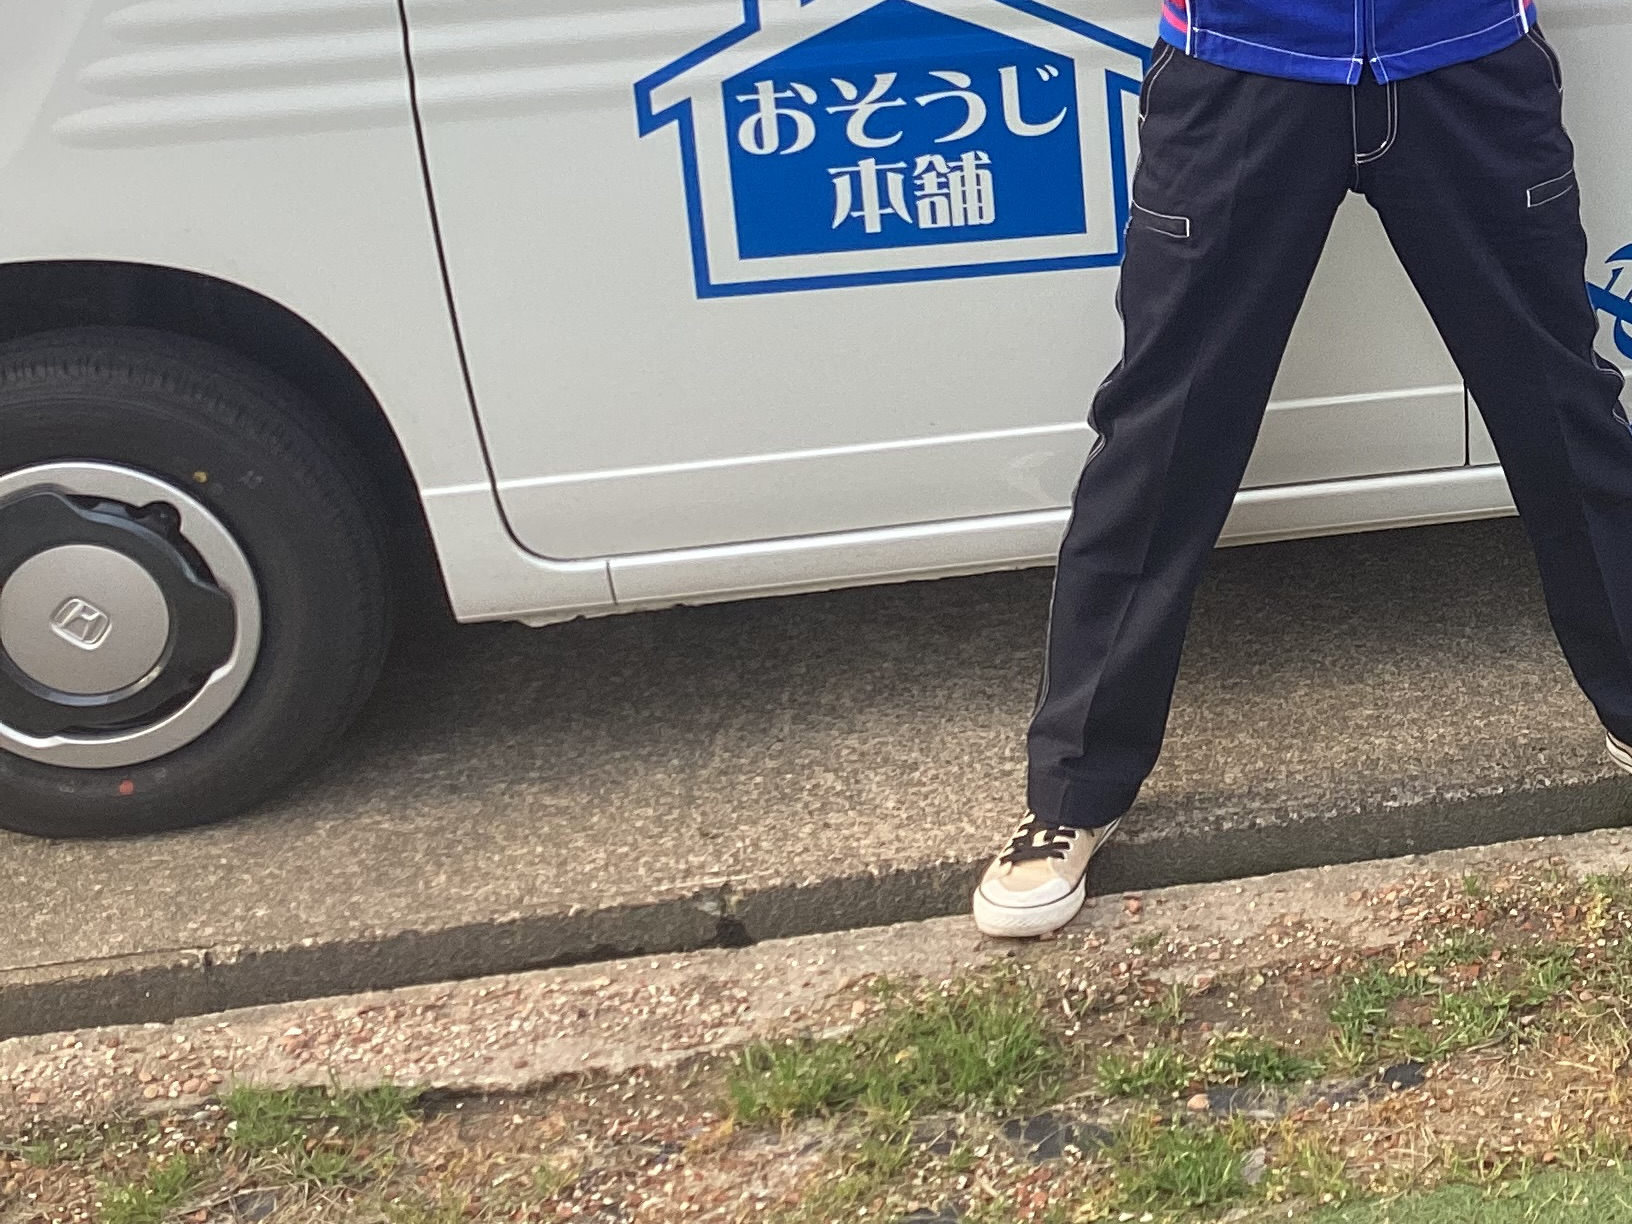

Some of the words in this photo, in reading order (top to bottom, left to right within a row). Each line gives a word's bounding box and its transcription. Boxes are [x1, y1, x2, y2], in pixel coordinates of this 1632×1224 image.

[736, 64, 1068, 156] おそうじ
[827, 150, 996, 234] 本舗
